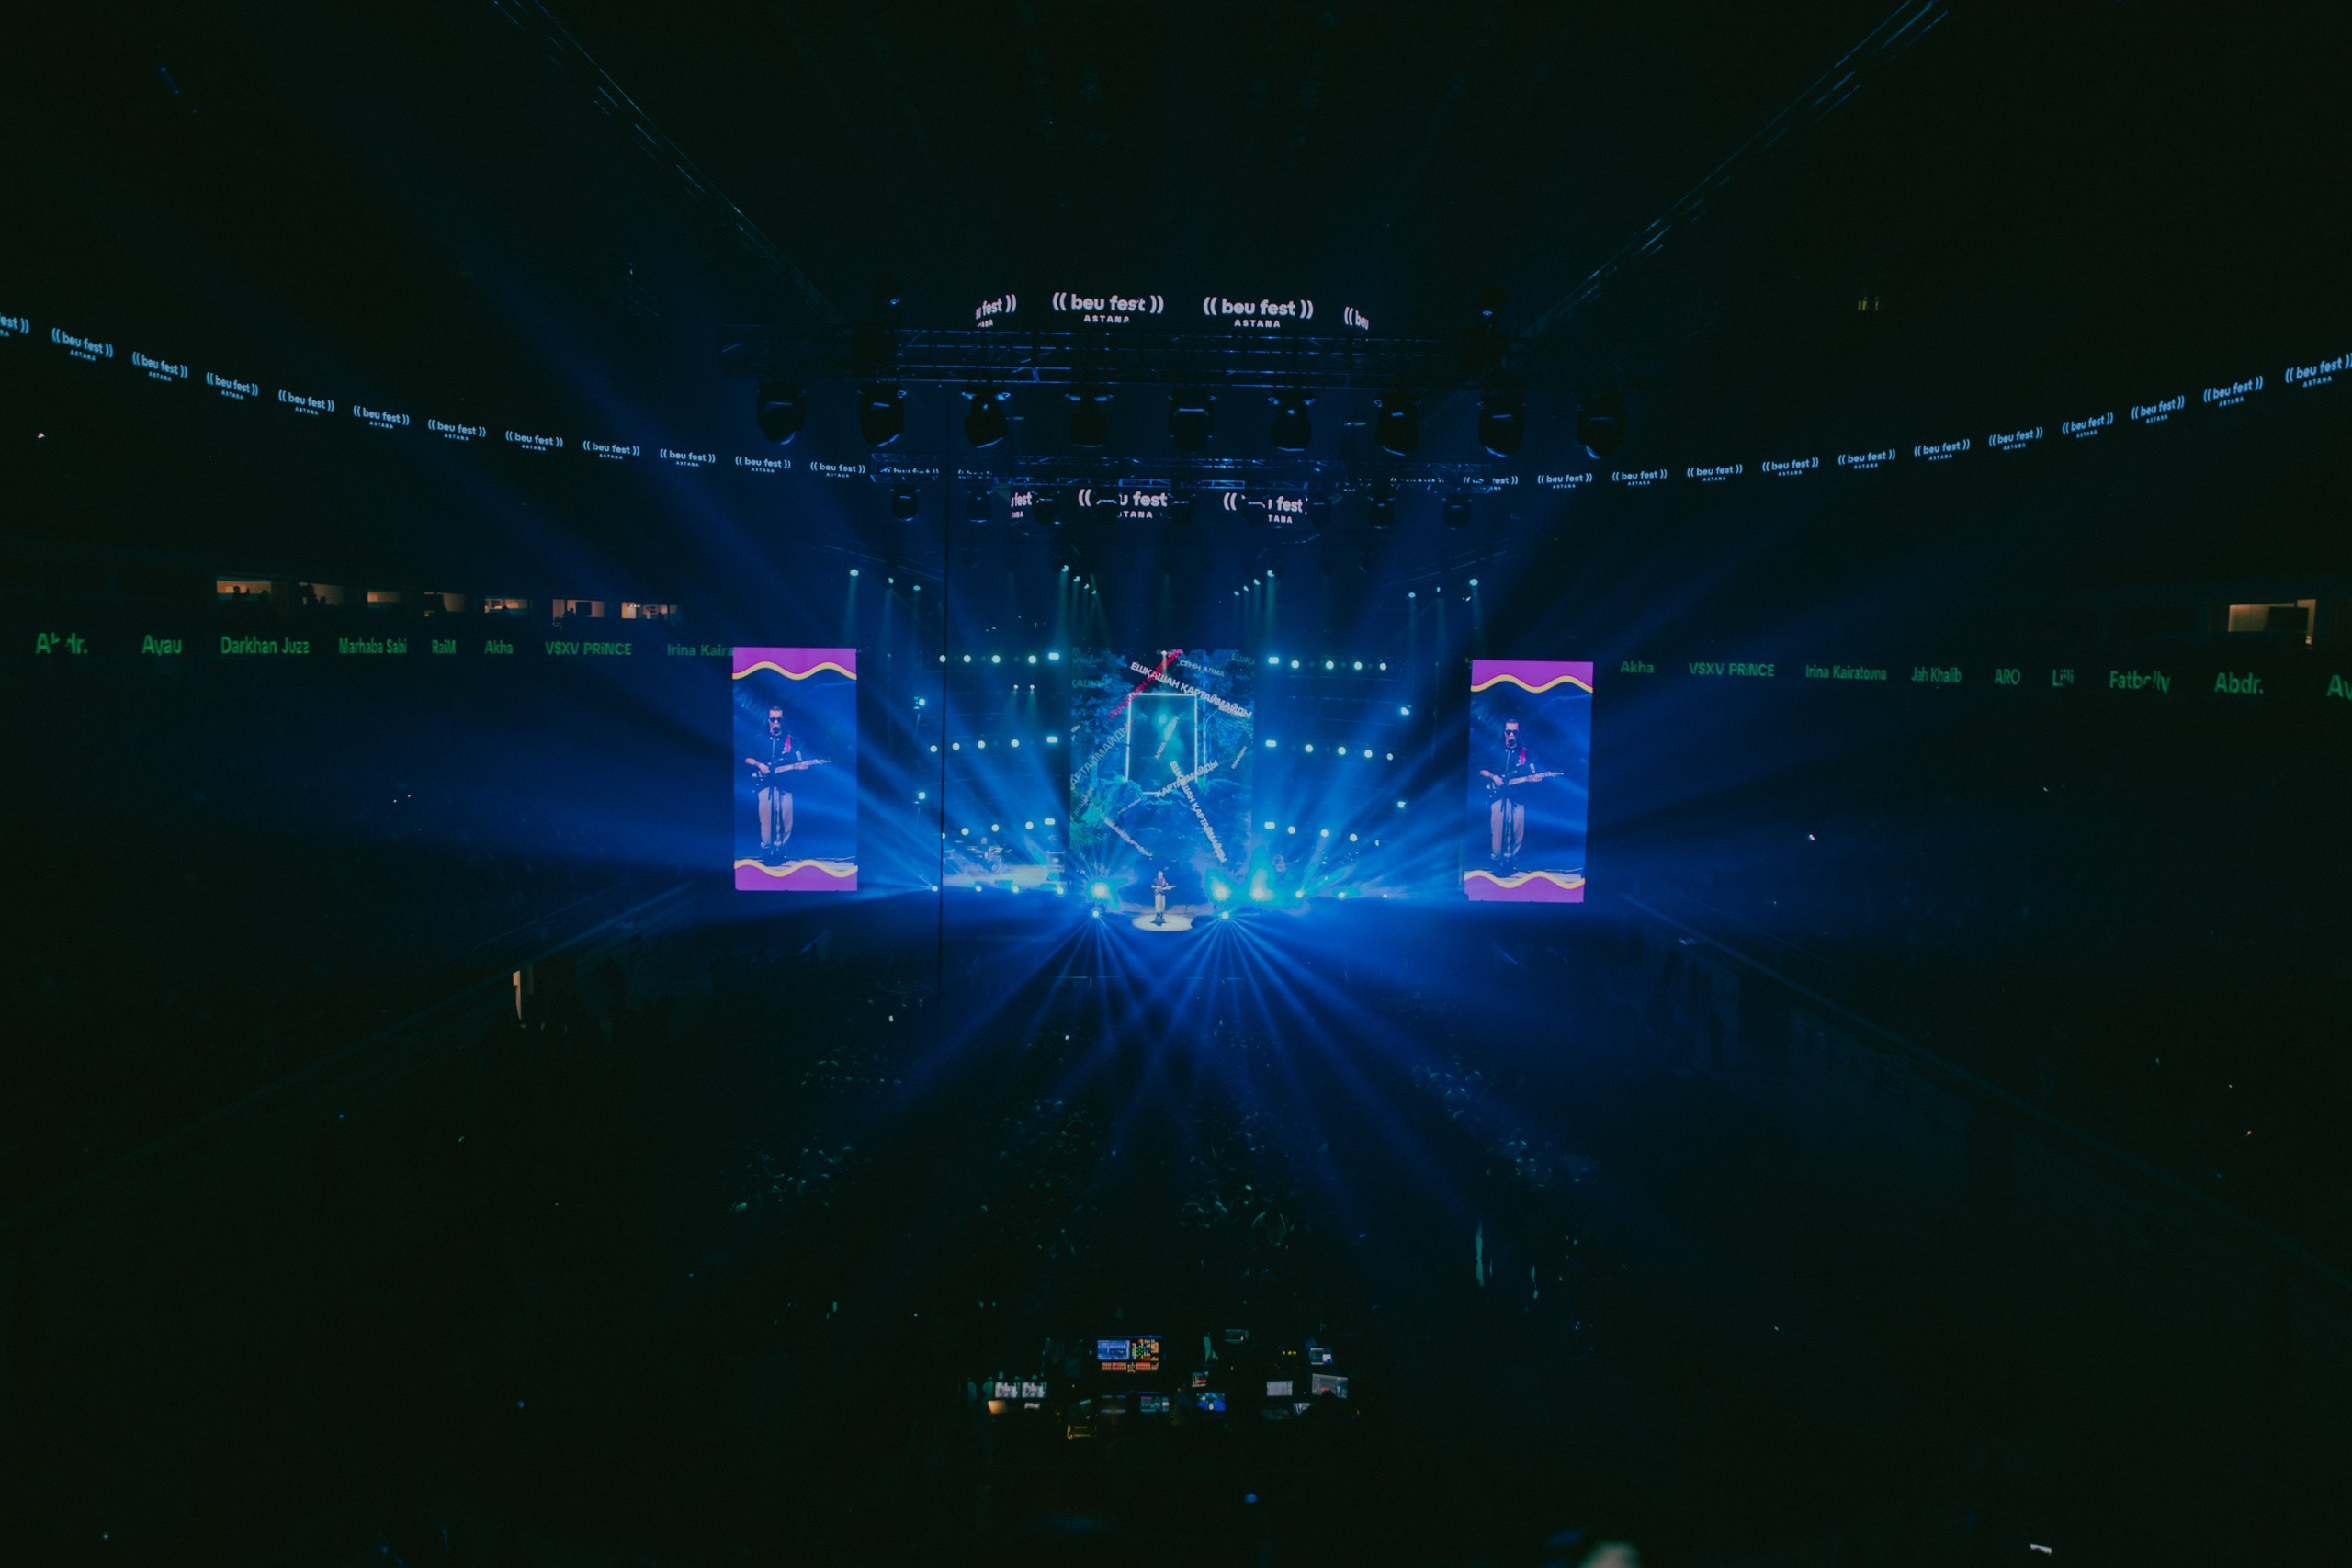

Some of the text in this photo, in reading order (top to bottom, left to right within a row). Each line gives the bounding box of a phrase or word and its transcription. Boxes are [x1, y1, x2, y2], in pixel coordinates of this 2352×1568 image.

[1070, 294, 1146, 311] beu fest
[1221, 298, 1296, 316] beu fest
[1083, 314, 1130, 323] ASTANA
[1234, 319, 1281, 328] ASTANA
[62, 331, 104, 354] beu fest
[141, 355, 178, 376] beu fest
[2297, 356, 2343, 380] beu fest
[215, 374, 251, 393] beu fest
[2213, 379, 2253, 400] beu fest
[288, 391, 326, 410] beu fest
[2141, 399, 2176, 417] beu fest
[362, 407, 401, 423] beu fest
[2071, 414, 2105, 432] beu fest
[436, 420, 477, 435] beu fest
[514, 432, 554, 446] beu fest
[1997, 428, 2034, 444] beu fest
[592, 441, 630, 455] beu fest
[669, 450, 706, 462] beu fest
[1923, 441, 1961, 455] beu fest
[744, 457, 782, 468] beu fest
[1771, 458, 1810, 470] beu fest
[1847, 450, 1886, 464] beu fest
[1546, 473, 1583, 483] beu fest
[1621, 470, 1658, 480] beu fest
[1696, 465, 1734, 477] beu fest
[1133, 491, 1168, 507] fest
[1276, 495, 1303, 513] fest
[1268, 514, 1293, 524] TANA
[220, 636, 310, 654] Darkhan Juzz
[338, 637, 384, 654] Marhaba
[484, 640, 514, 654] Akha
[545, 640, 580, 656] V$XV
[667, 643, 696, 657] Irina
[1620, 660, 1655, 673] Akha
[1689, 661, 1724, 676] V$XV
[1805, 664, 1887, 681] Irina Kairatovna
[1911, 666, 1928, 682] Jah
[1130, 661, 1180, 689] ЕШҚАШАН
[1994, 668, 2021, 685] ARO
[2213, 671, 2264, 694] Abdr.
[1071, 725, 1128, 790] АРТАЙМАЙДЫ
